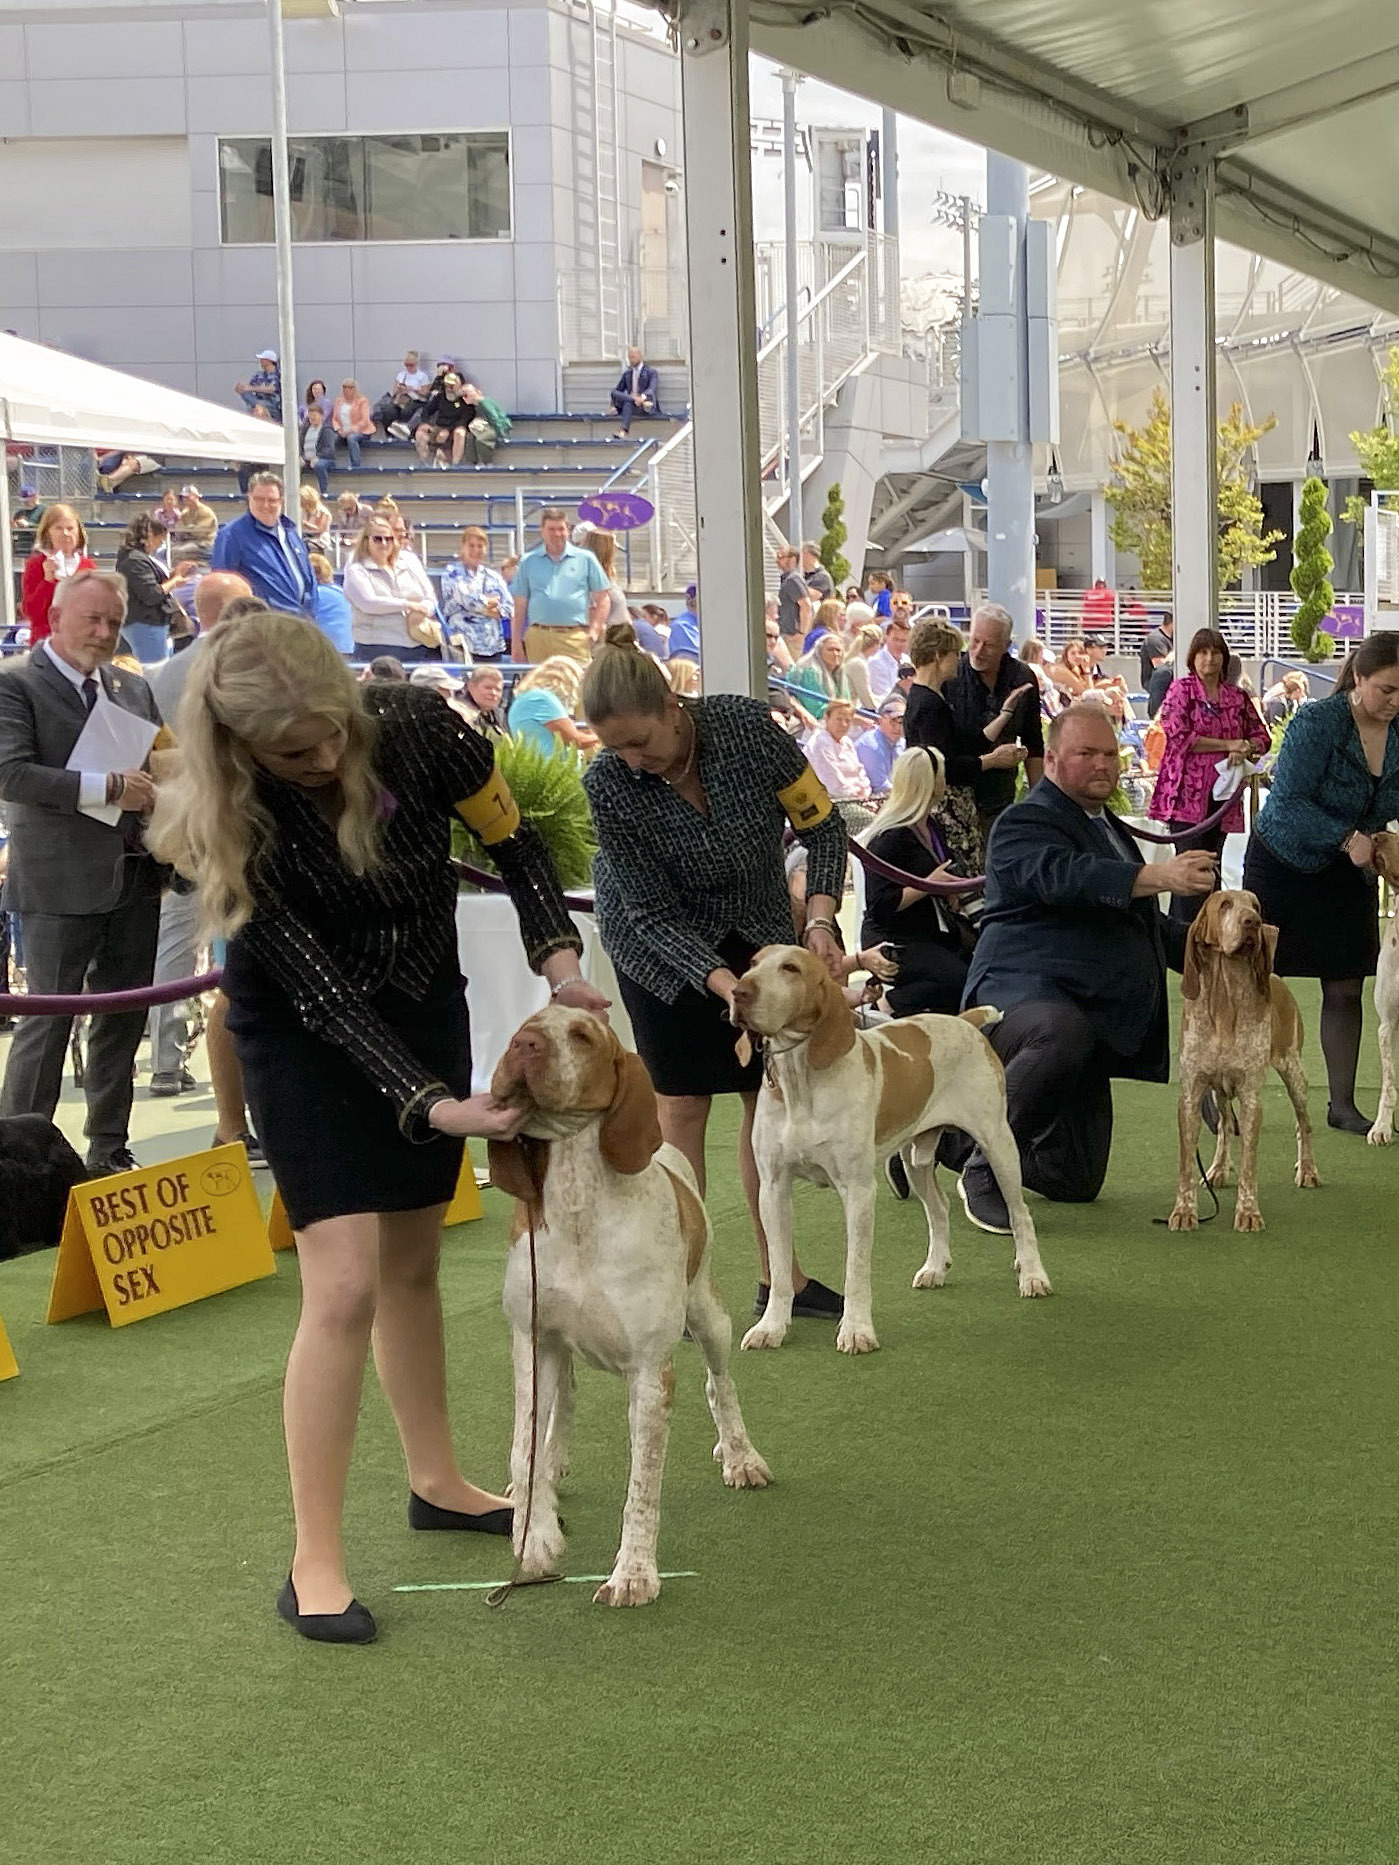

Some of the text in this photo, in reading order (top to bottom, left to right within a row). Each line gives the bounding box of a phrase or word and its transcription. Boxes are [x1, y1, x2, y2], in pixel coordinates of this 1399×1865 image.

[90, 1173, 190, 1228] BEST OF
[103, 1205, 217, 1264] OPPOSITE
[113, 1264, 161, 1306] SEX
